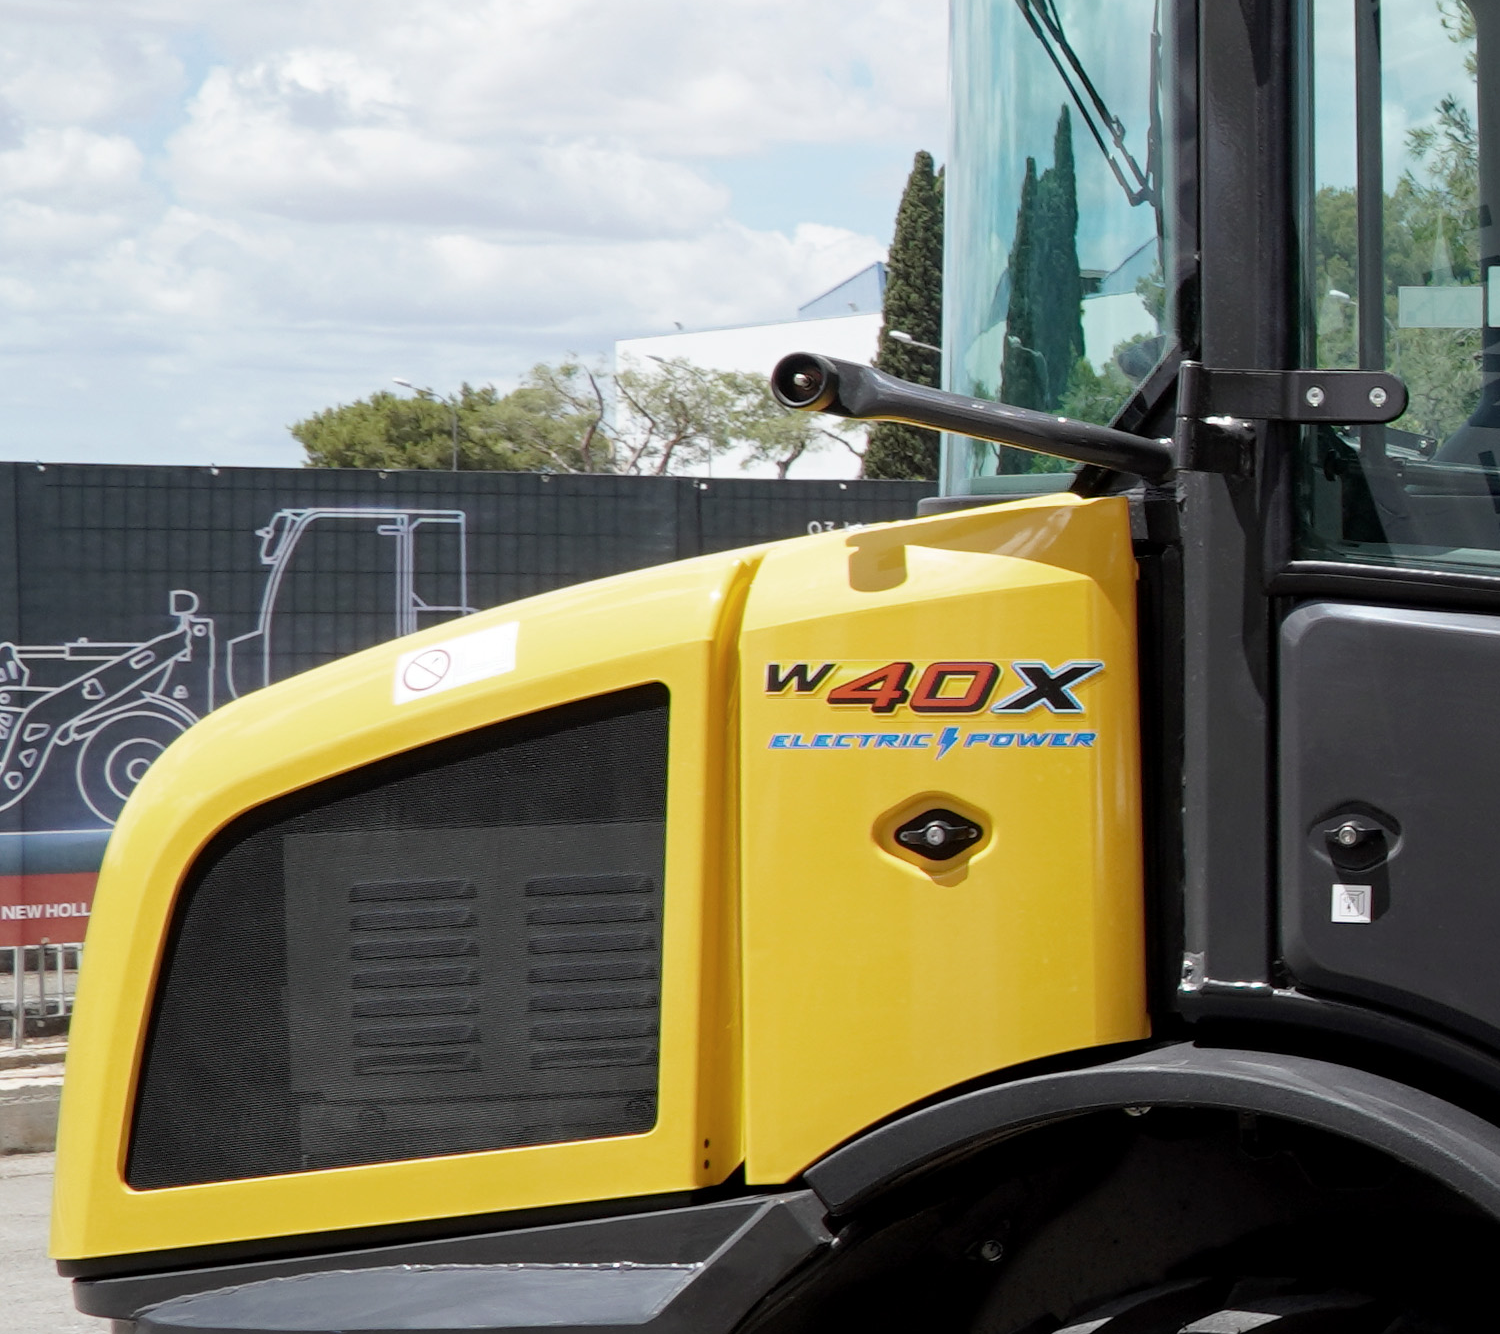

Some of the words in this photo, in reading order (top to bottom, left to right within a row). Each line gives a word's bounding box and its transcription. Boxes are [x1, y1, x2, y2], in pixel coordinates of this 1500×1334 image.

[765, 660, 1105, 715] W40X
[767, 733, 934, 749] ELECTRIC
[963, 731, 1097, 748] POWER
[1, 904, 42, 920] NEW
[45, 902, 92, 918] HOLL
